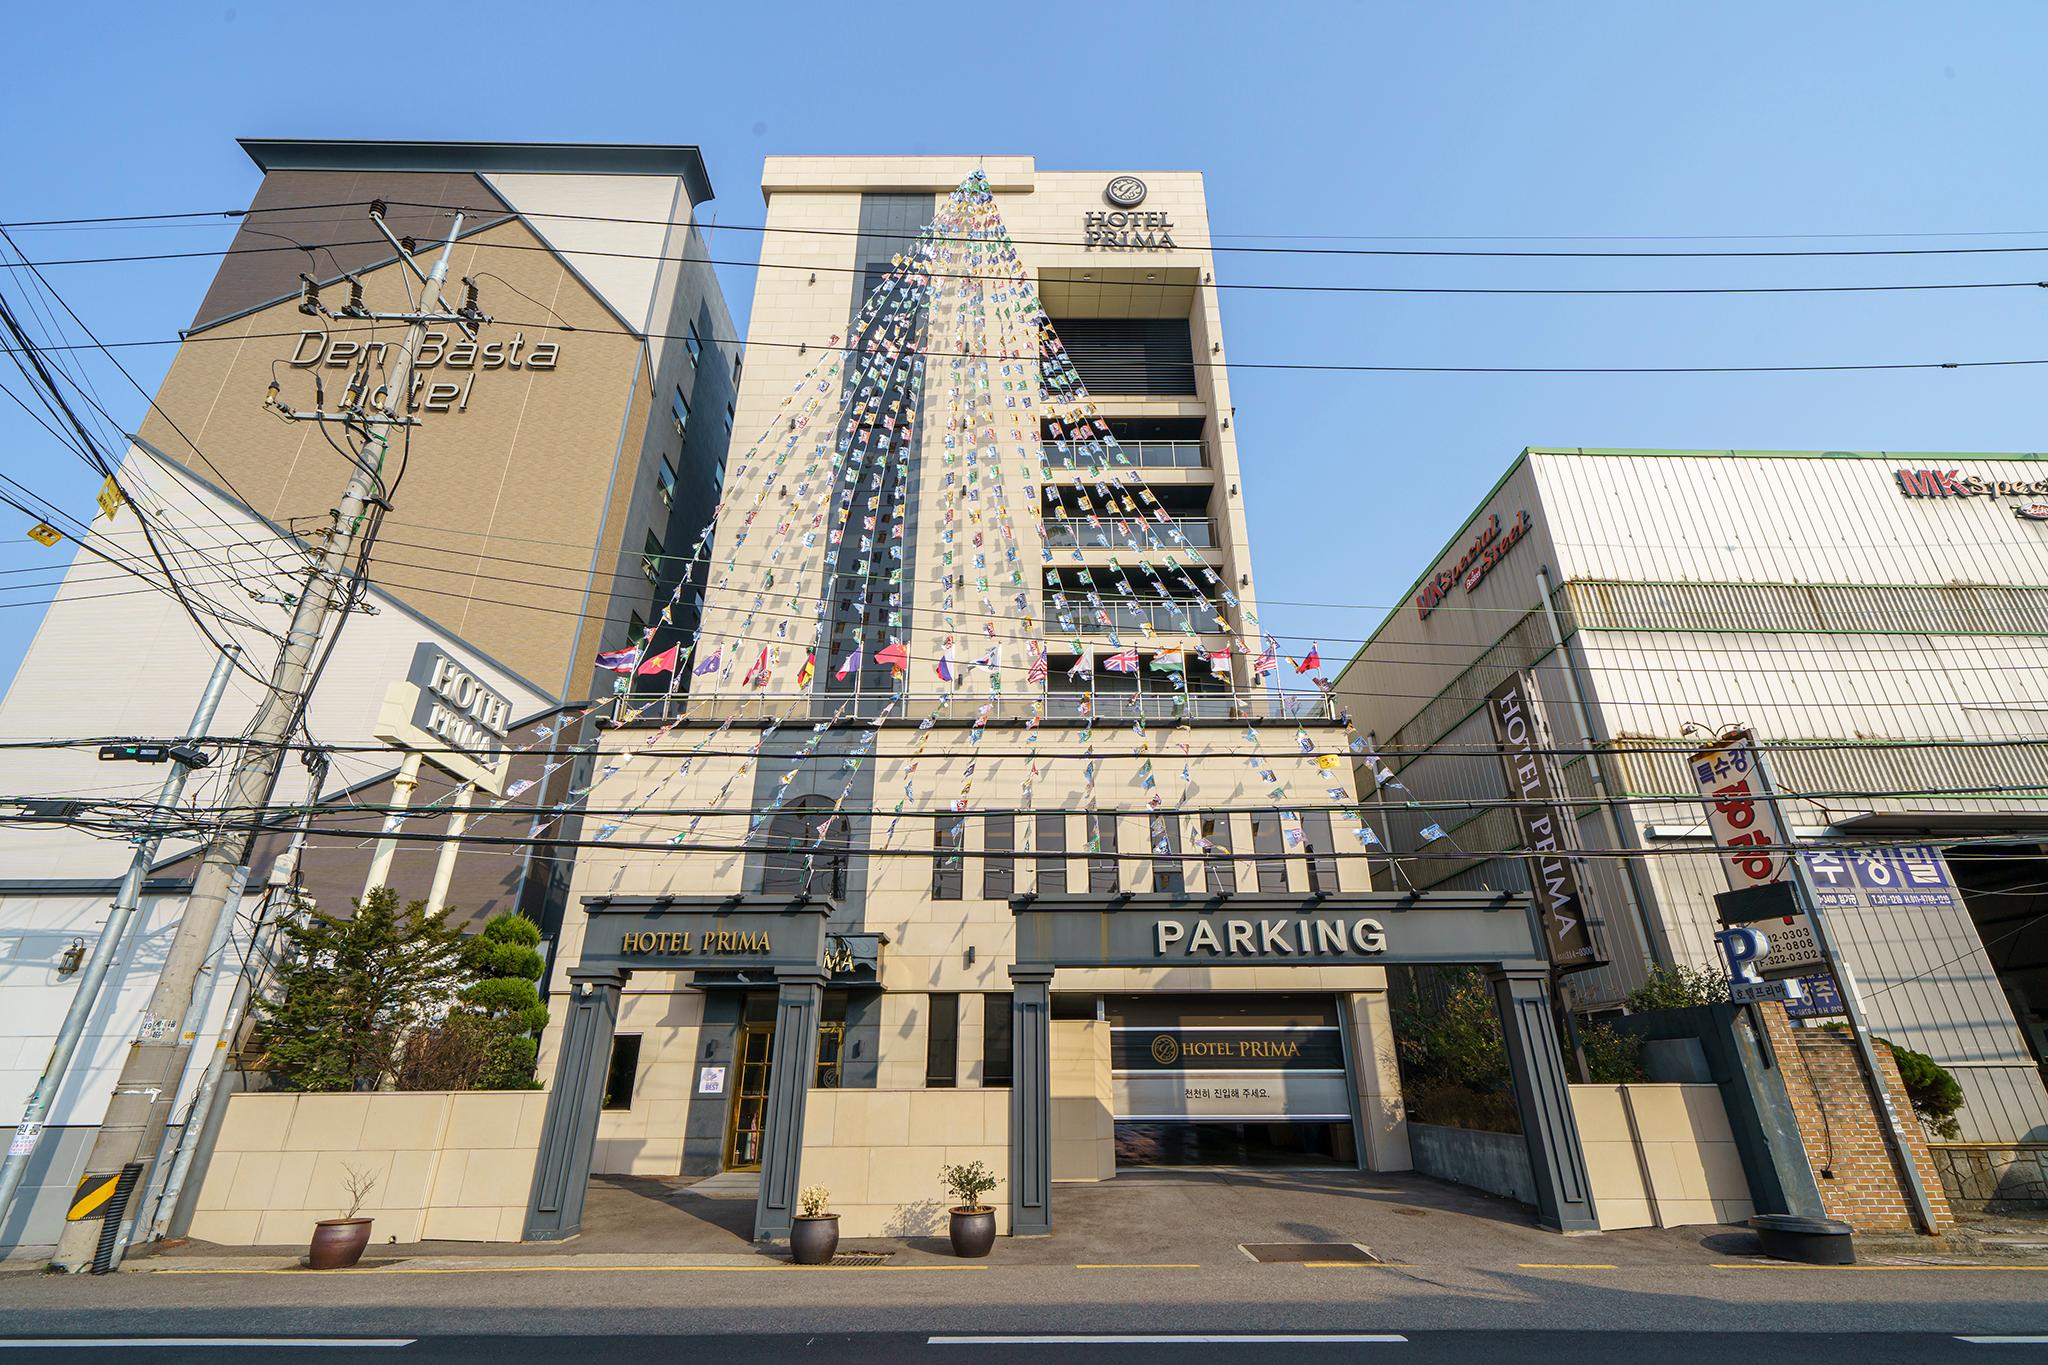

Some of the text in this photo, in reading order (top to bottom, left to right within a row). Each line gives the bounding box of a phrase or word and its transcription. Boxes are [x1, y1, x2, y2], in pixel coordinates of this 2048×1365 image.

[1085, 211, 1174, 227] HOTEL
[1086, 230, 1177, 248] PRIMA
[290, 330, 388, 367] Den
[428, 654, 509, 739] HOTEL
[426, 702, 492, 764] PRIMA
[1696, 748, 1749, 785] 특수강
[1500, 686, 1577, 941] HOTEL PRIMA
[623, 930, 771, 952] HOTEL PRIMA
[1156, 918, 1388, 954] PARKING
[1767, 927, 1810, 943] 12-0303
[1182, 1041, 1301, 1057] HOTEL PRIMA
[1184, 1088, 1270, 1099] 천천히 진입해 주세요.
